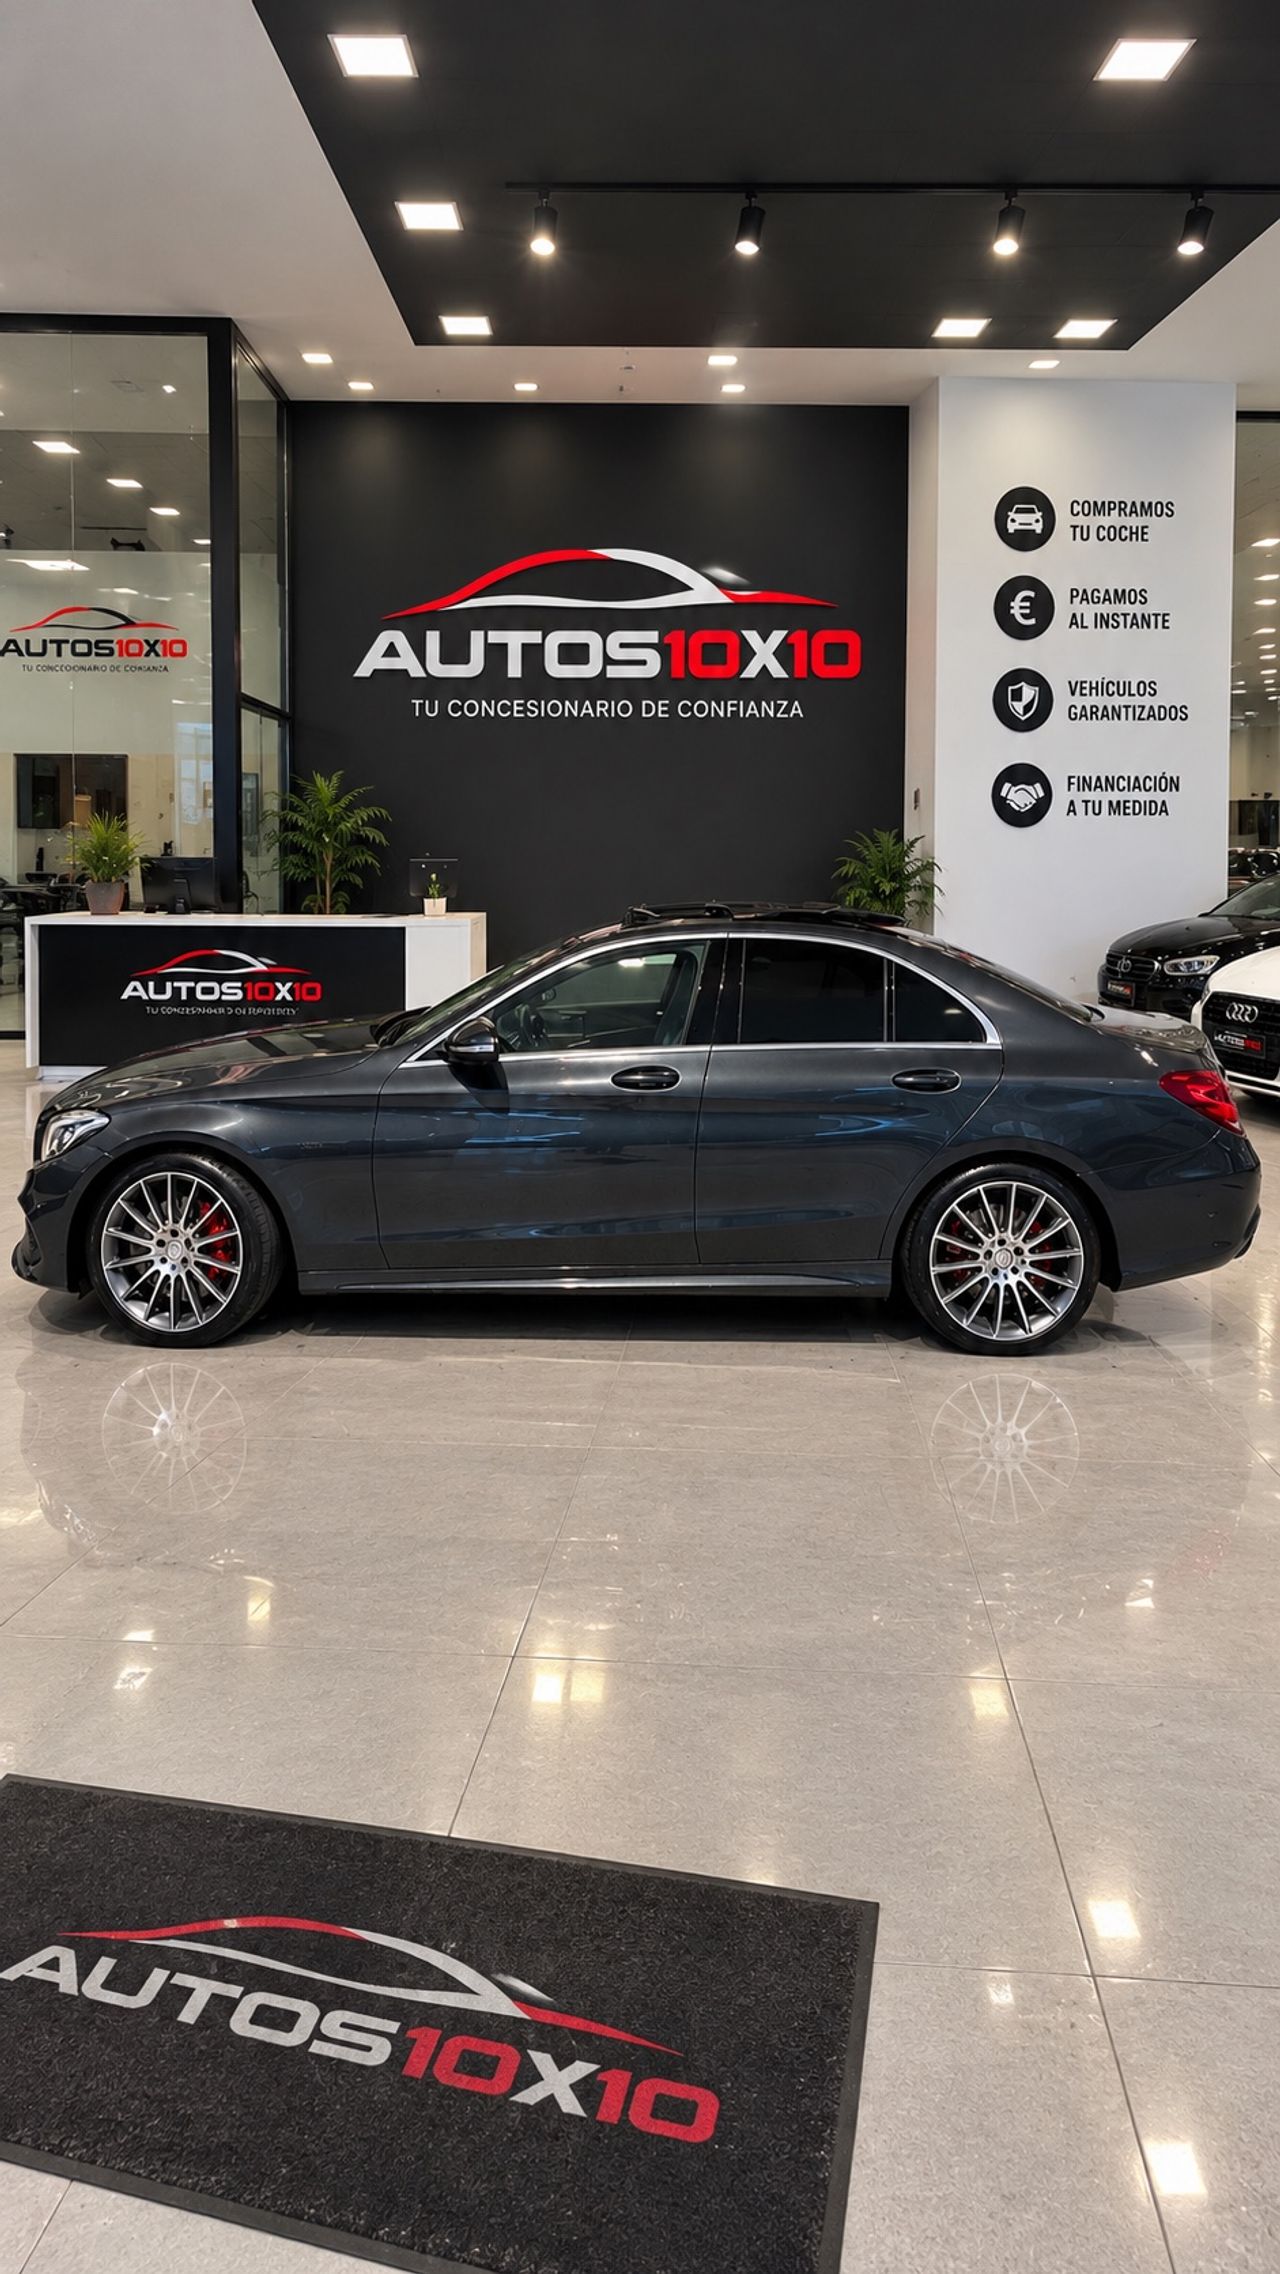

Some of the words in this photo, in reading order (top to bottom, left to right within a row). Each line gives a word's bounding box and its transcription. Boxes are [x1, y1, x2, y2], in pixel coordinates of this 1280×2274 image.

[1071, 500, 1175, 518] COMPRAMOS
[1070, 525, 1090, 542] TU
[1097, 525, 1149, 542] COCHE
[1070, 588, 1148, 605] PAGAMOS
[1069, 613, 1088, 629] AL
[1094, 613, 1170, 629] INSTANTE
[0, 638, 188, 658] AUTOS10X10
[353, 630, 862, 678] AUTOS10X10
[1068, 677, 1158, 698] VEHÍCULOS
[412, 700, 438, 717] TU
[448, 700, 633, 717] CONCESIONARIO
[642, 700, 669, 717] DE
[678, 700, 804, 717] CONFIANZA
[1068, 705, 1188, 722] GARANTIZADOS
[1067, 772, 1180, 792] FINANCIACIÓN
[1067, 800, 1077, 816] A
[1082, 800, 1102, 816] TU
[1108, 800, 1169, 816] MEDIDA
[120, 981, 322, 1001] AUTOS10X10
[0, 1945, 721, 2143] AUTOS10X10
